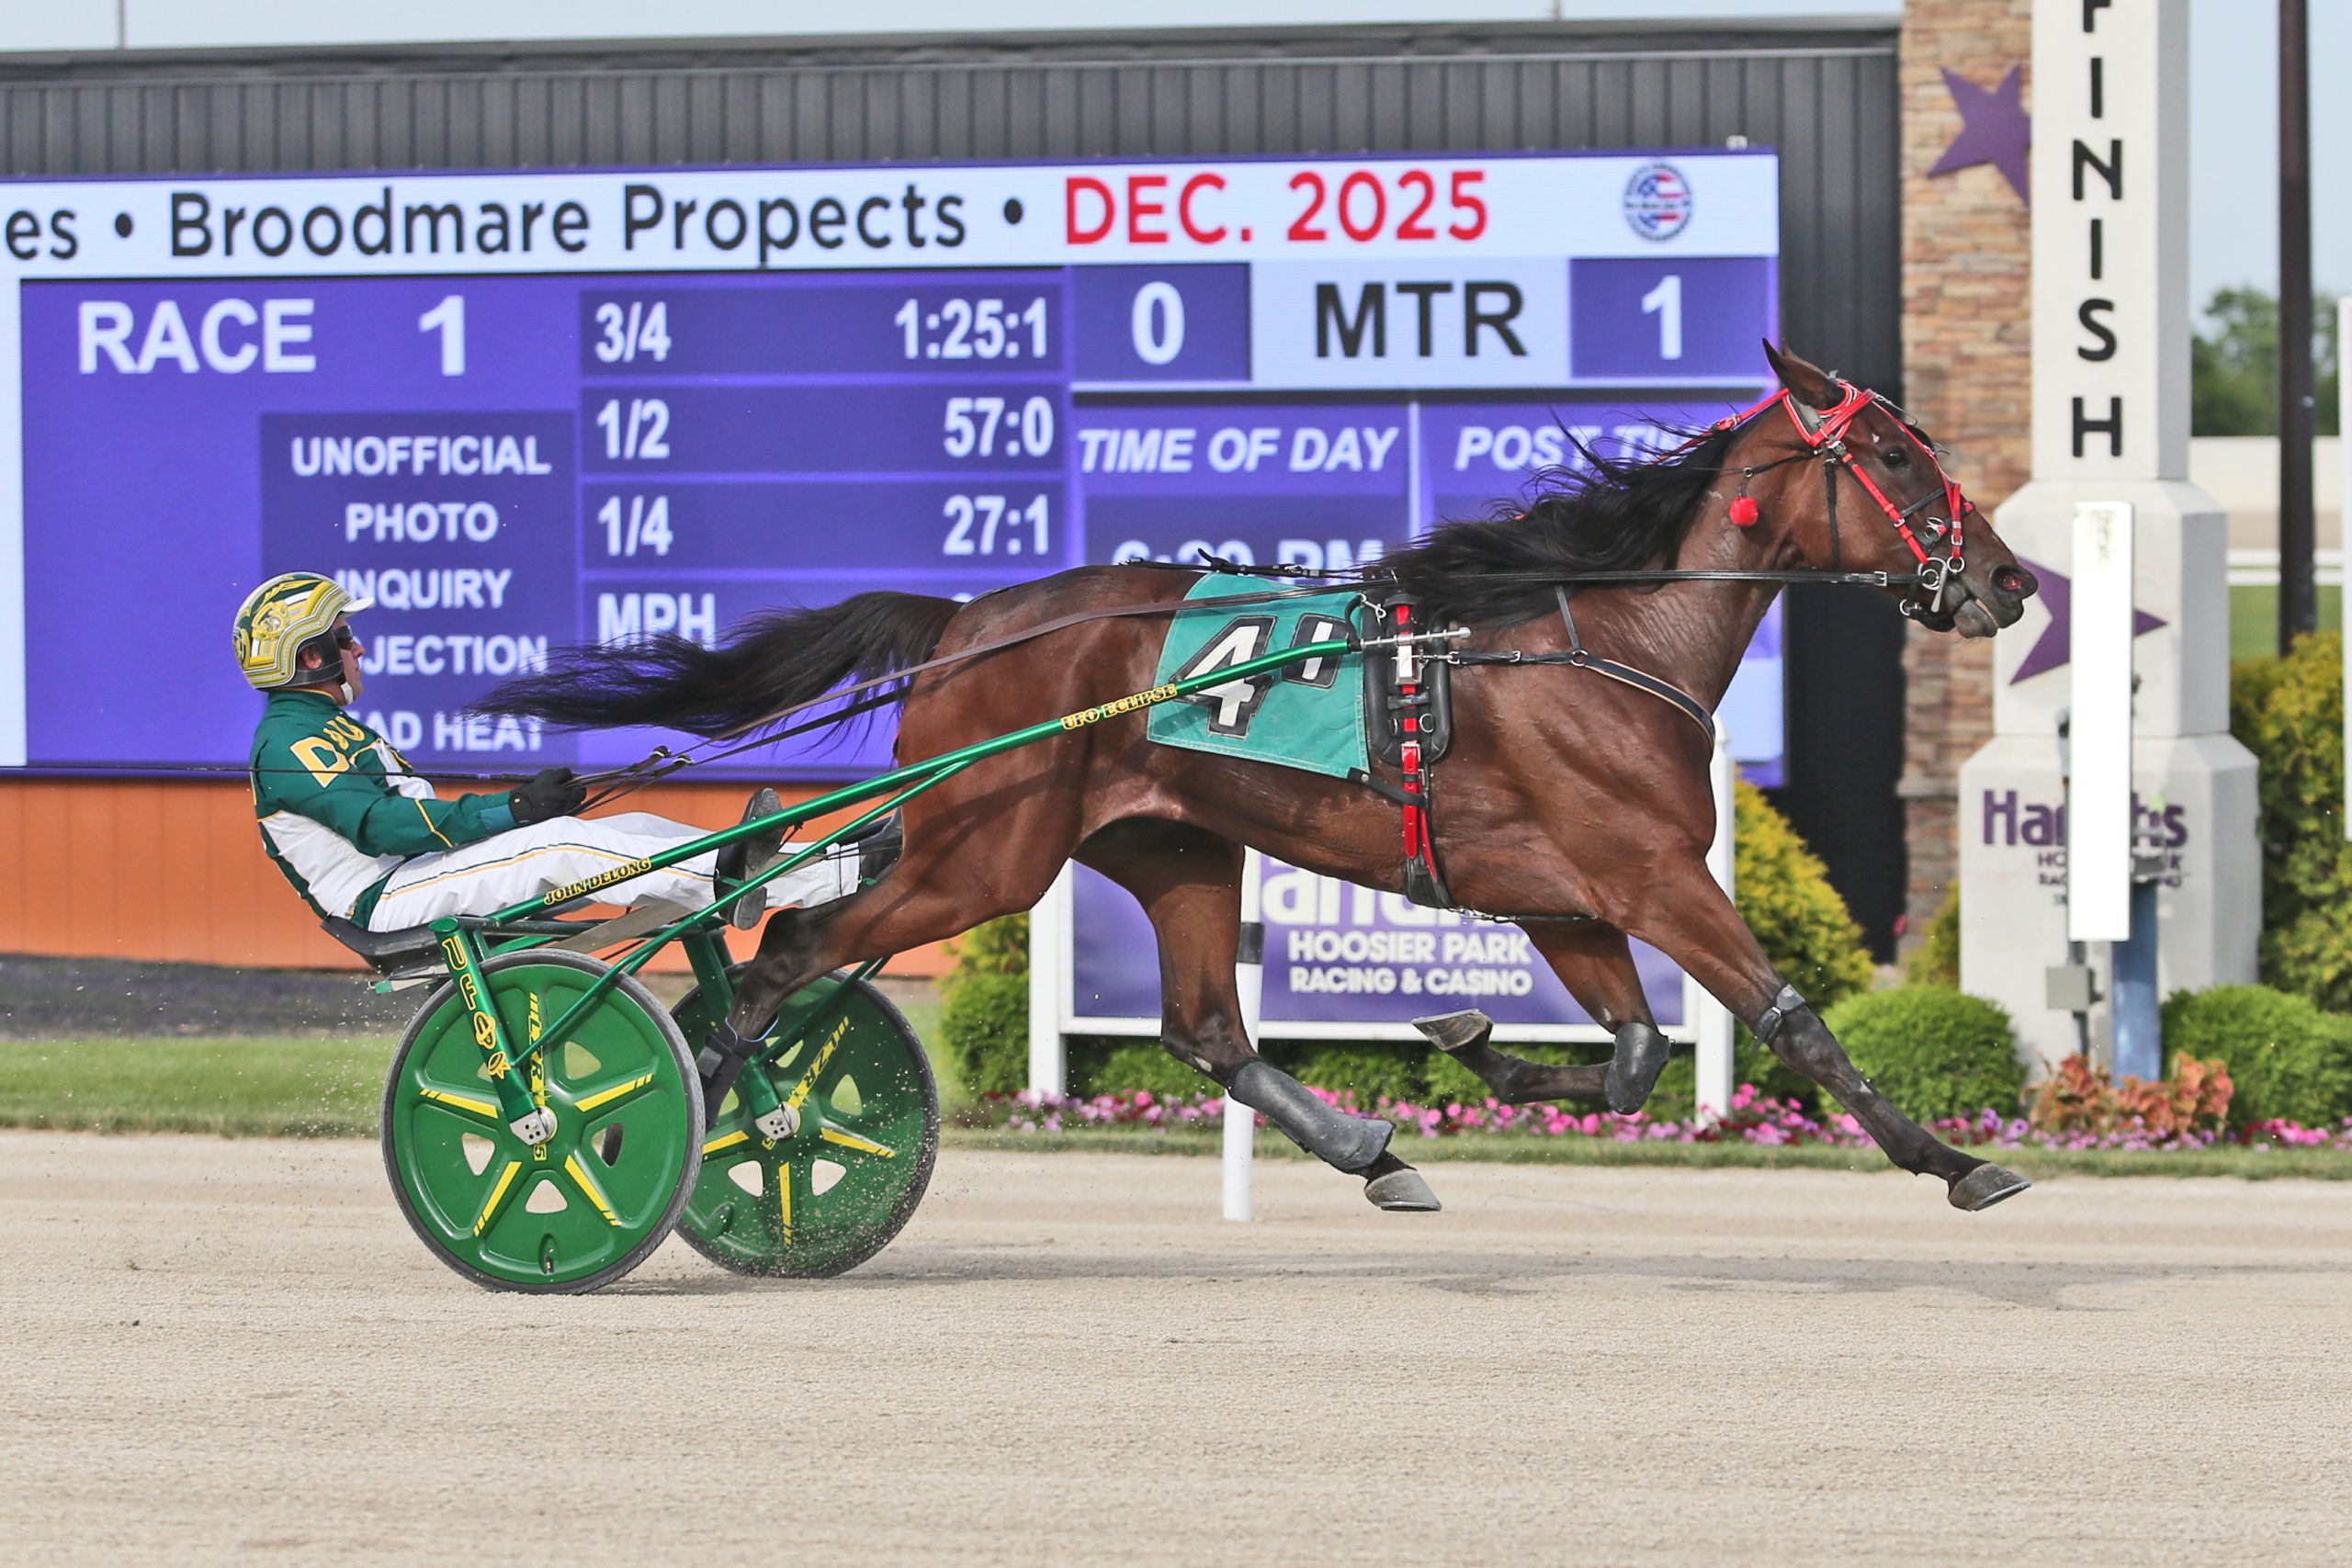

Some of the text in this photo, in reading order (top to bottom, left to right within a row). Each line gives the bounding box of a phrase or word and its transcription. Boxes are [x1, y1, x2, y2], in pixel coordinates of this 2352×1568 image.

[172, 186, 589, 258] Broodmare
[624, 183, 966, 267] Propects
[1066, 174, 1252, 245] DEC.
[1286, 171, 1487, 242] 2025
[78, 294, 465, 377] RACE 1
[595, 297, 1047, 363] 3/4 1:25:1
[1131, 281, 1185, 366] 0
[1316, 275, 1683, 361] MTR 1
[596, 397, 1055, 459] 1/2 57:0
[1077, 426, 1400, 472] TIME OF DAY
[1454, 425, 1604, 471] POST
[290, 435, 552, 477] UNOFFICIAL
[345, 502, 500, 544] PHOTO
[597, 493, 1050, 557] 1/4 27:1
[334, 568, 513, 610] INQUIRY
[598, 592, 717, 650] MPH
[355, 634, 548, 676] JECTION
[1174, 619, 1268, 733] 4
[1060, 683, 1178, 729] UFO ECLIPSE
[544, 857, 651, 905] JOHN DELONG
[1288, 930, 1532, 964] HOOSIER PARK
[1289, 966, 1533, 998] RACING & CASINO
